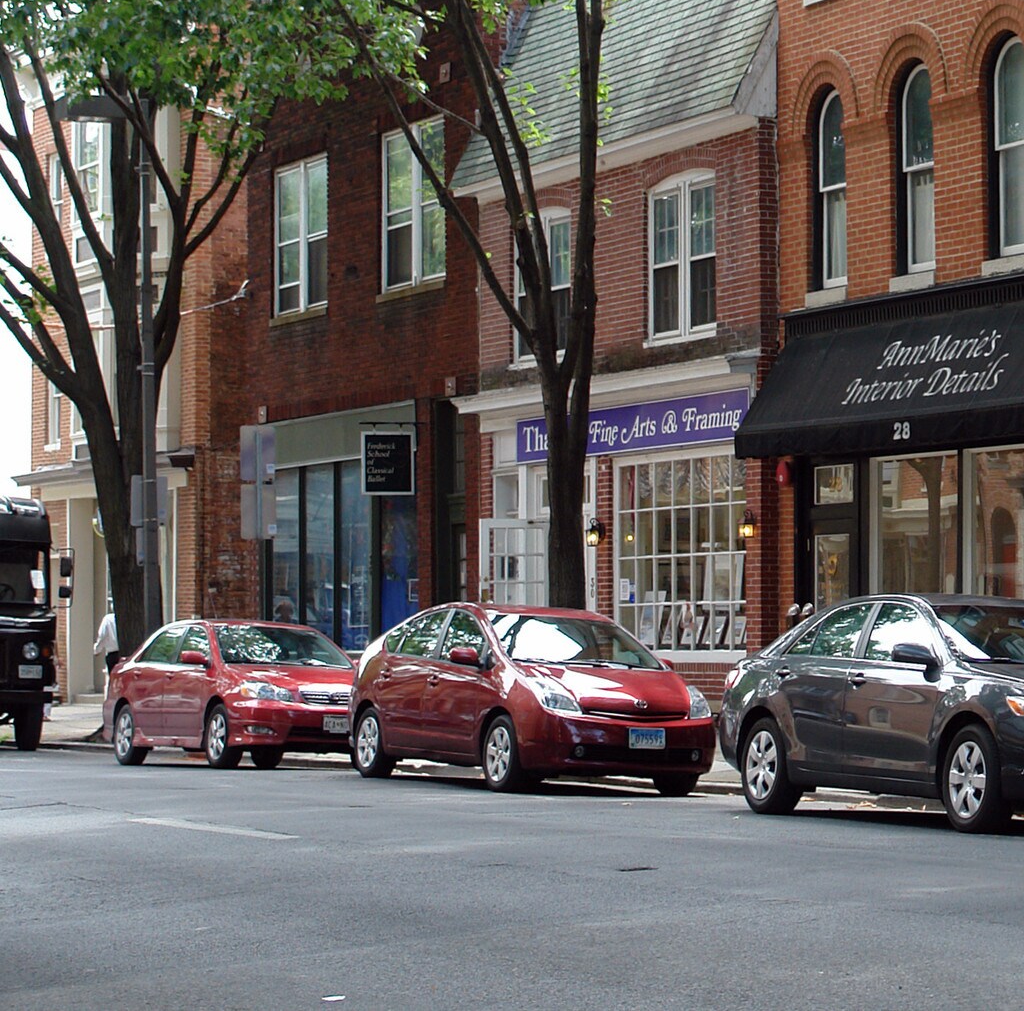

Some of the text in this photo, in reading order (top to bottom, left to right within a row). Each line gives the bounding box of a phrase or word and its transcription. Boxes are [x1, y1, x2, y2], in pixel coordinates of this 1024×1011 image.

[876, 328, 1002, 370] AnnMarie's
[841, 352, 1009, 405] Interior Details
[589, 419, 618, 446] Fine
[620, 415, 657, 444] Arts
[661, 410, 678, 434] &
[682, 404, 742, 432] Framing
[893, 421, 911, 440] 28
[367, 450, 390, 458] School
